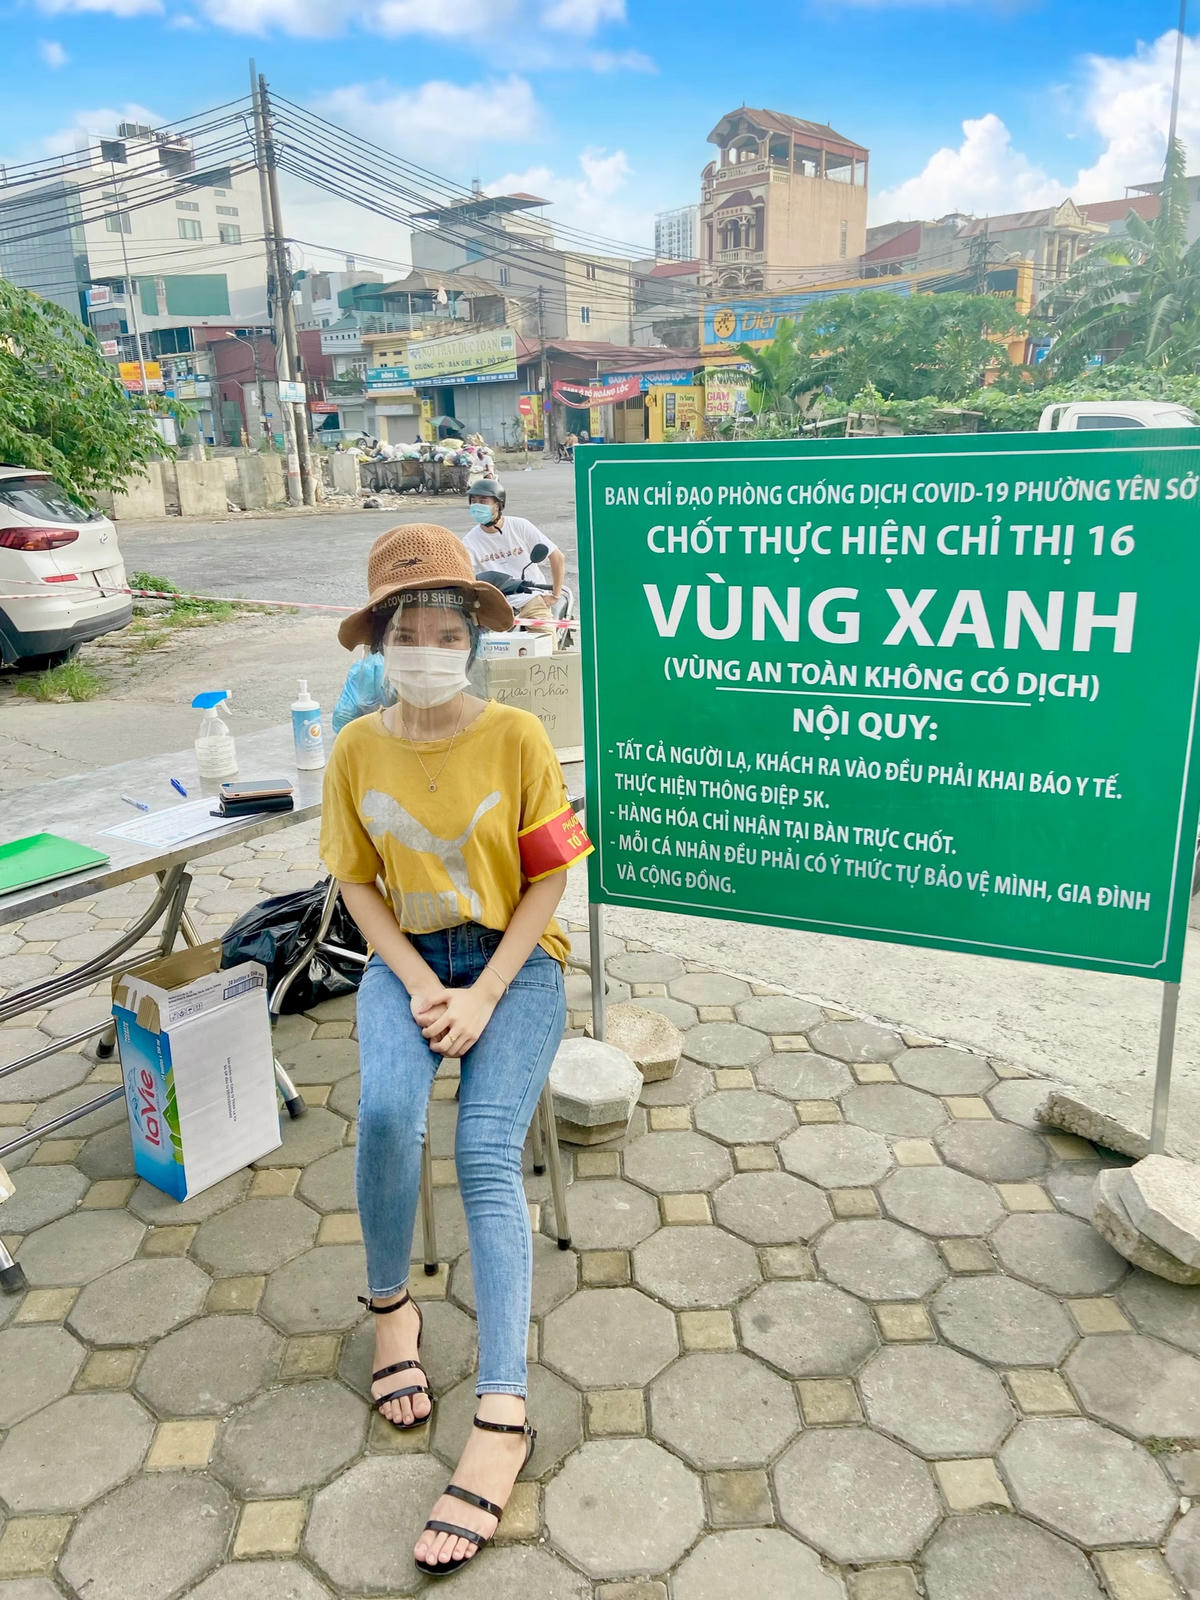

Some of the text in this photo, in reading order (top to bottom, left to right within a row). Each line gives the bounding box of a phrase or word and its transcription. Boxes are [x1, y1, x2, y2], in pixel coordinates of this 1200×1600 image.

[606, 471, 1200, 510] BAN CHỈ ĐẠO PHÒNG CHỐNG DỊCH COVID-19 PHƯỜNG YÊN SỞ
[648, 515, 1135, 564] CHỐT THỰC HIỆN CHỈ THỊ 16
[431, 592, 464, 605] SHIELD
[643, 573, 1137, 653] VÙNG XANH
[665, 654, 1099, 702] (VÙNG AN TOÀN KHÔNG CÓ DỊCH)
[794, 705, 937, 740] NỘI QUY:
[615, 773, 829, 809] THỰC HIỆN THÔNG ĐIỆP 5K.
[646, 740, 666, 762] CẢ
[671, 746, 722, 766] NGƯỜI
[728, 751, 750, 773] LẠ,
[757, 752, 813, 774] KHÁCH
[819, 758, 840, 776] RA
[845, 757, 881, 779] VÀO
[885, 759, 922, 782] ĐỀU
[928, 762, 972, 786] PHẢI
[978, 770, 1024, 791] KHAI
[1030, 771, 1071, 794] BÁO
[1077, 777, 1089, 795] Y
[1093, 774, 1121, 799] TẾ.
[666, 807, 698, 827] HÓA
[703, 810, 729, 830] CHỈ
[734, 815, 780, 839] NHẬN
[784, 821, 808, 842] TẠI
[814, 821, 848, 843] BÀN
[853, 827, 899, 851] TRỰC
[904, 830, 956, 854] CHỐT.
[617, 862, 735, 893] VÀ CỘNG ĐỒNG.
[652, 836, 671, 855] CÁ
[676, 840, 720, 860] NHÂN
[724, 843, 756, 864] ĐỀU
[762, 848, 799, 870] PHẢI
[805, 853, 826, 872] CÓ
[829, 854, 842, 875] Ý
[844, 859, 891, 880] THỨC
[896, 863, 921, 888] TỰ
[925, 864, 962, 888] BẢO
[967, 871, 989, 896] VỆ
[995, 874, 1051, 902] MÌNH,
[1058, 884, 1091, 904] GIA
[1097, 885, 1150, 910] ĐÌNH
